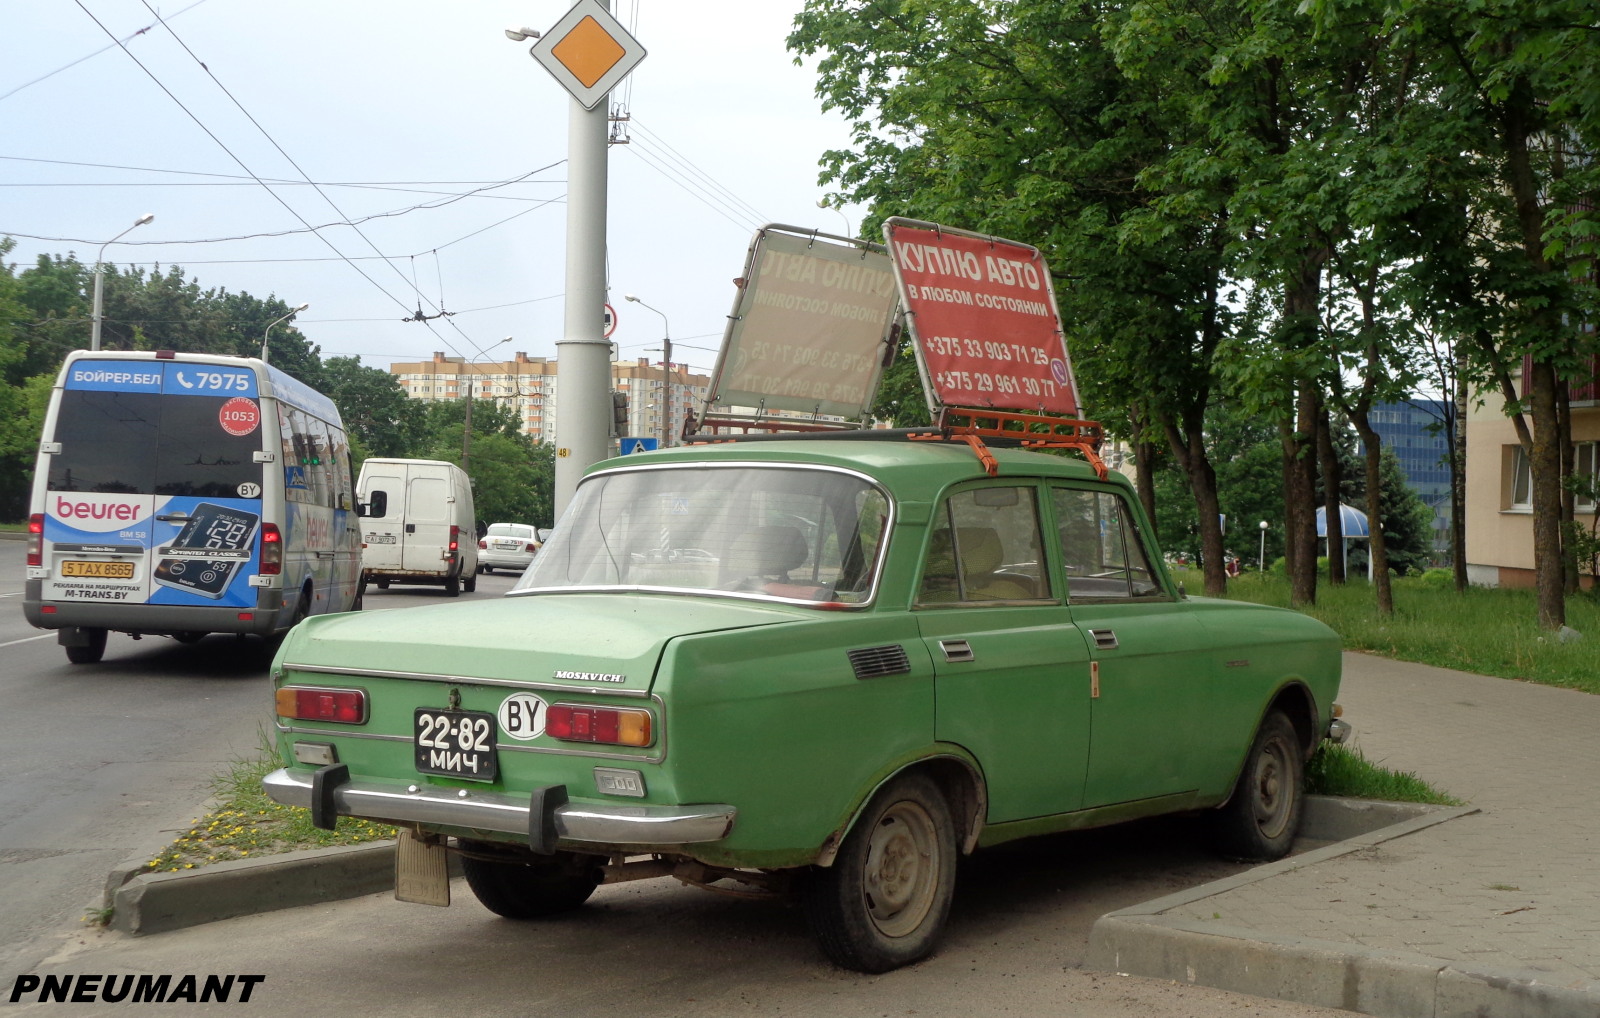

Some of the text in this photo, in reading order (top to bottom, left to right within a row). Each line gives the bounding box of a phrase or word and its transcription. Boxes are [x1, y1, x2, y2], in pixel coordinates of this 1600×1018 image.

[895, 241, 1041, 291] КУПЛЮ АВТО
[908, 284, 1049, 317] В ЛЮБОМ СОСТОЯНИИ
[926, 336, 1049, 365] +375 33 903 71 25
[74, 370, 160, 385] БОЙРЕР.БЕЛ
[196, 372, 249, 391] 7975
[936, 371, 1056, 398] +375 29 961 30 77
[224, 411, 255, 422] 1053
[559, 448, 567, 457] 48
[240, 484, 256, 496] BY
[56, 496, 141, 520] beurer
[206, 520, 247, 543] 128
[67, 563, 132, 576] 5 TAX 8565
[213, 562, 227, 572] 69
[65, 590, 128, 599] M-TRANS.BY
[555, 670, 623, 682] MOSKVICH
[507, 700, 540, 732] BY
[418, 713, 490, 751] 22-82
[430, 749, 478, 773] МИЧ
